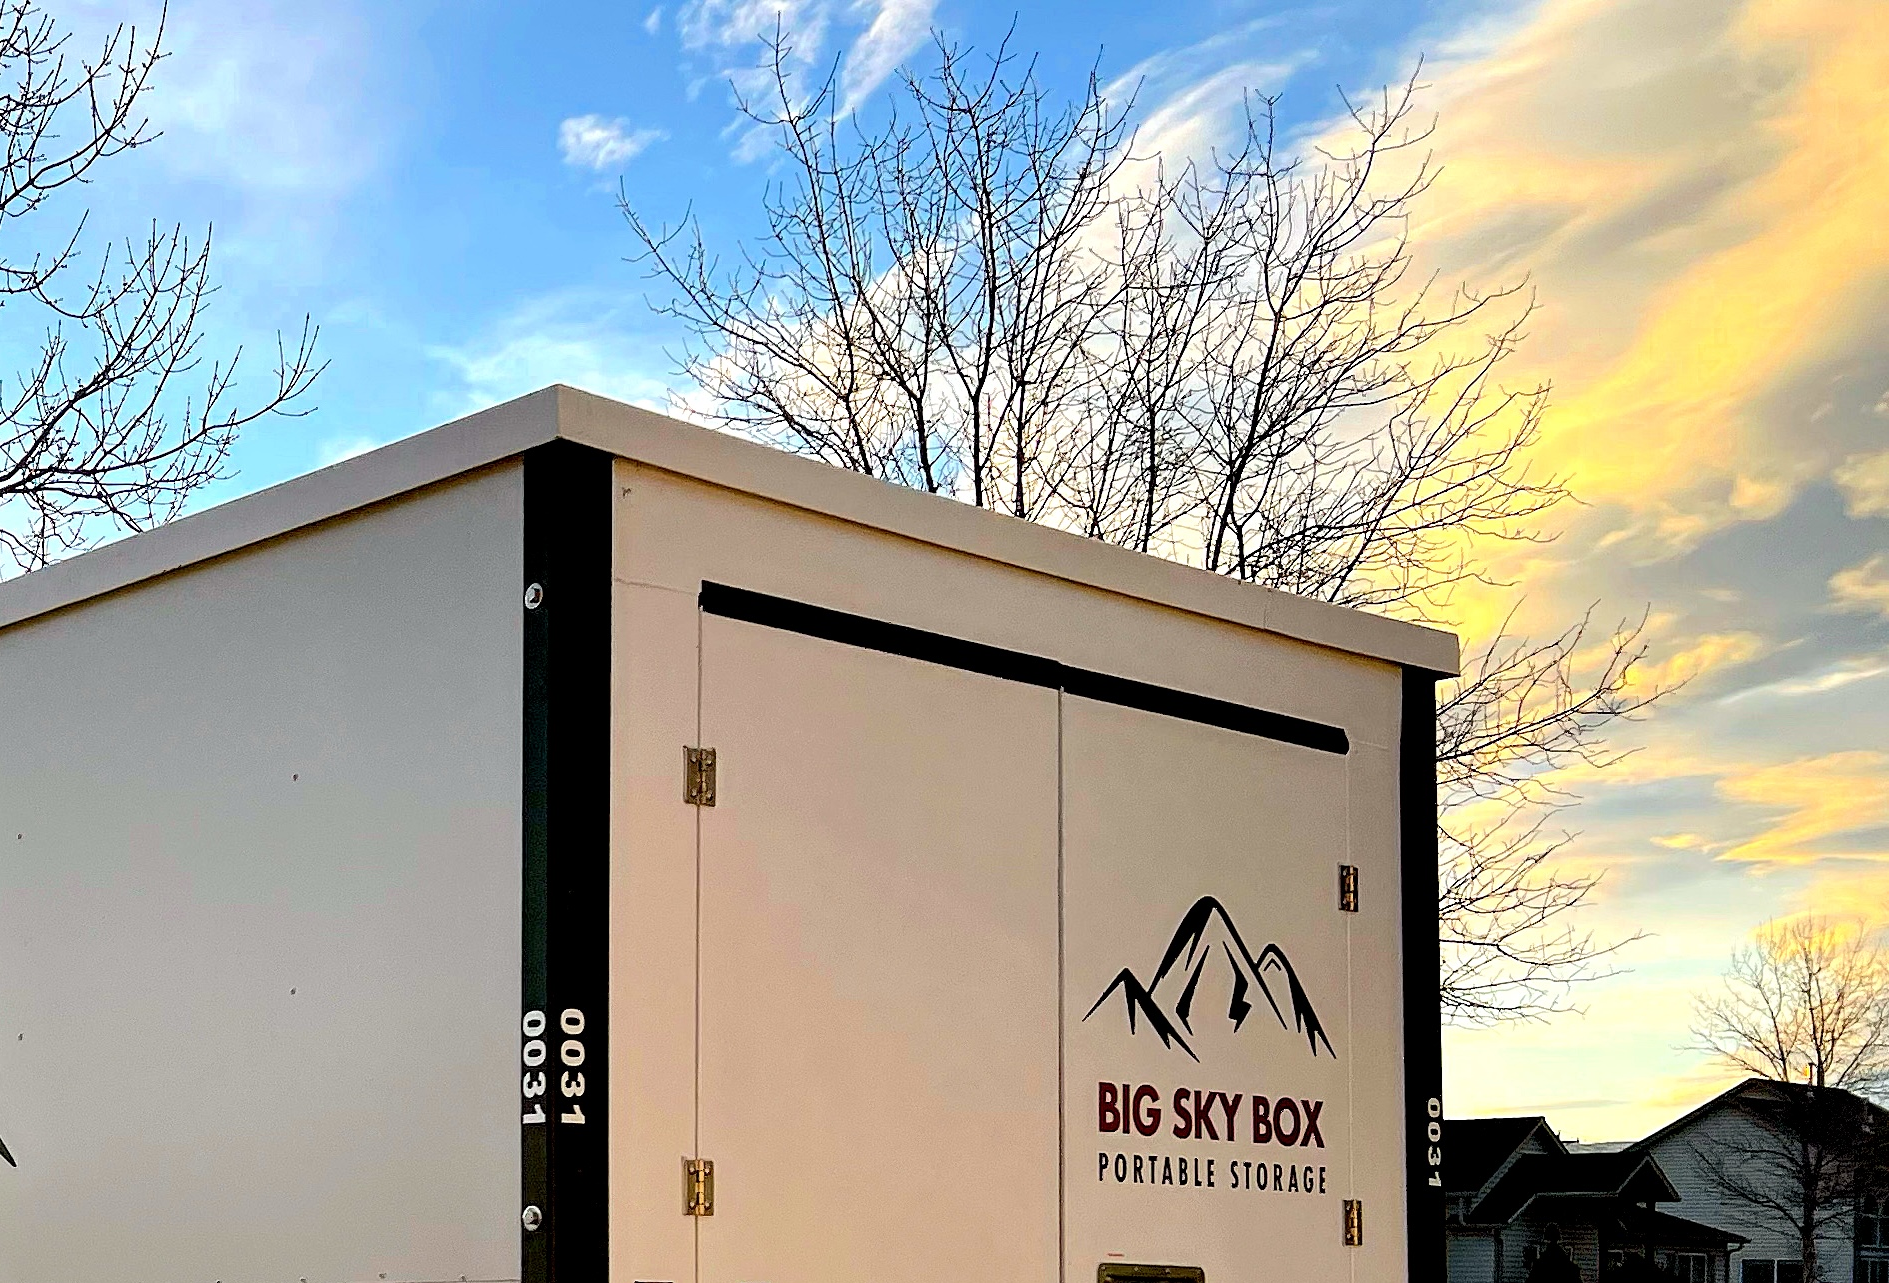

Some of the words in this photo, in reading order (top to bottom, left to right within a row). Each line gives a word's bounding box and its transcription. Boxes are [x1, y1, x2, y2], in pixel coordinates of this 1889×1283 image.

[523, 1010, 546, 1124] 0031
[560, 1008, 585, 1124] 0031
[1098, 1081, 1162, 1137] BIG
[1173, 1089, 1243, 1142] SKY
[1252, 1095, 1325, 1149] BOX
[1427, 1097, 1442, 1187] 0031
[1098, 1152, 1216, 1188] PORTABLE
[1230, 1160, 1327, 1195] STORAGE
